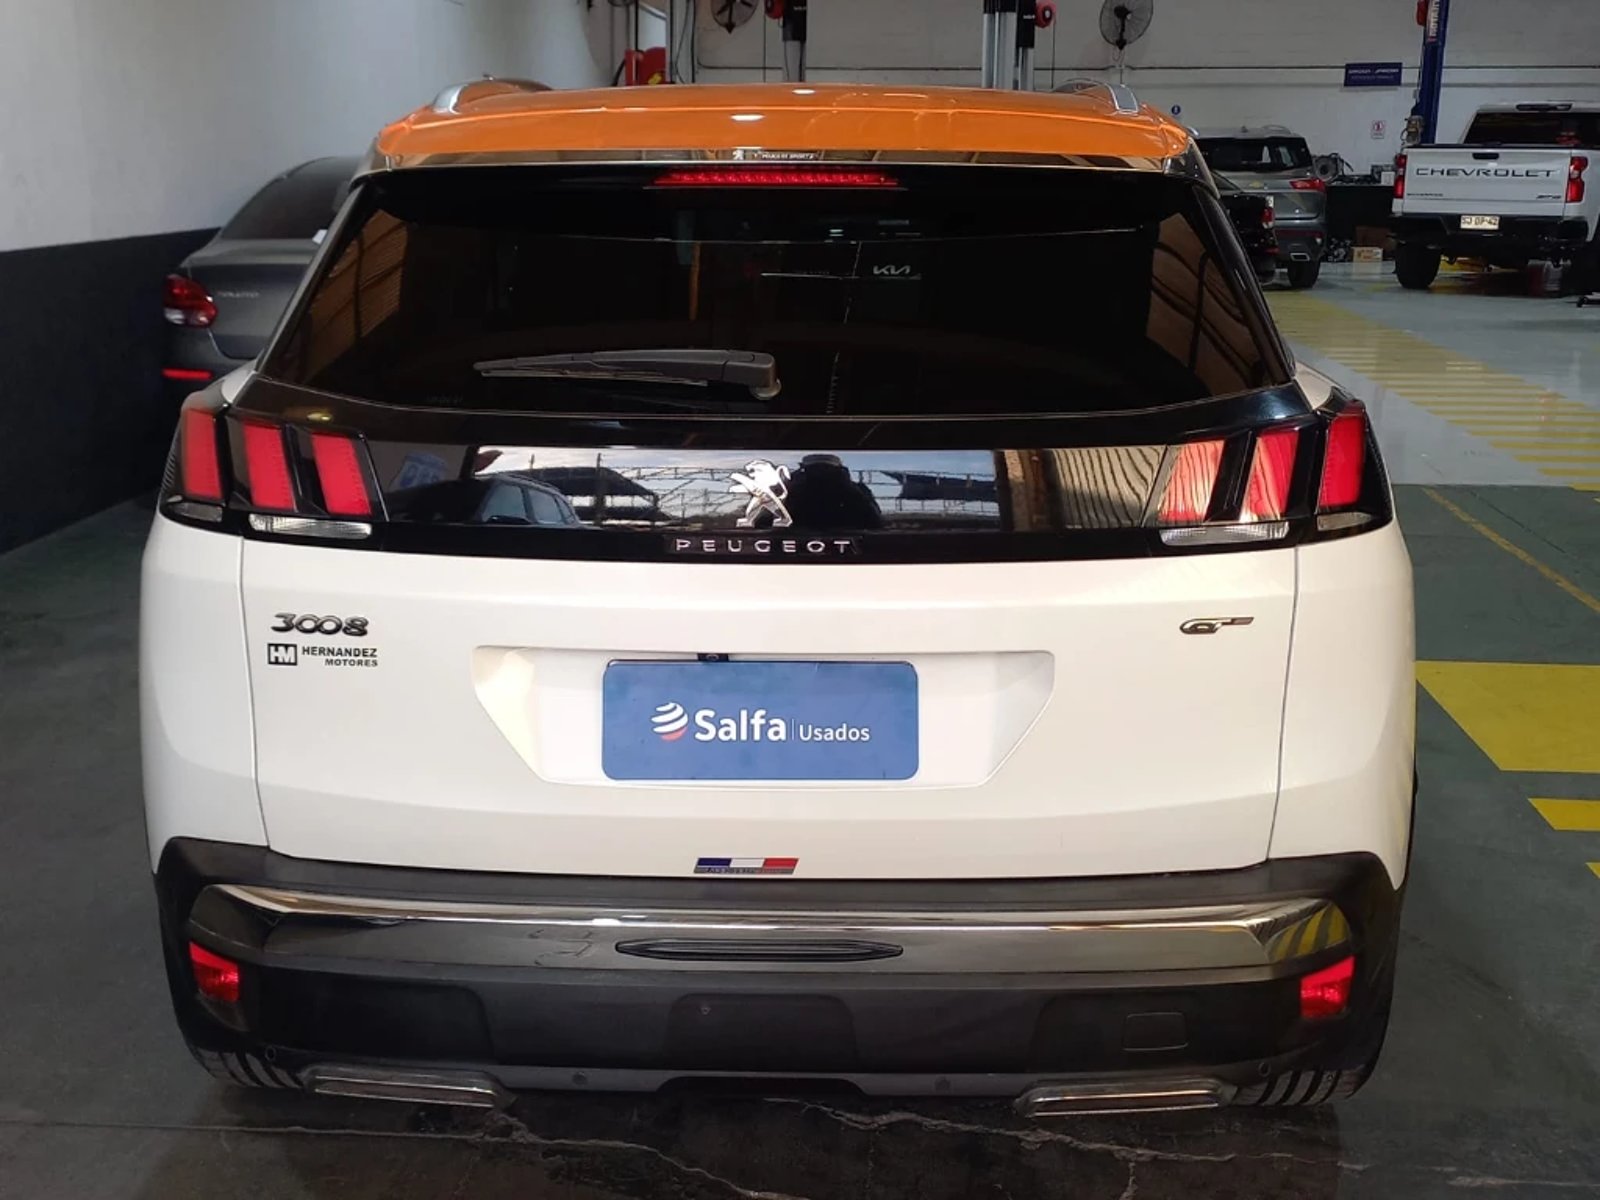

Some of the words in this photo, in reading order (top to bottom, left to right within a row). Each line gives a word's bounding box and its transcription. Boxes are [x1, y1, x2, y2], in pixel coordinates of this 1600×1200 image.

[1416, 168, 1559, 178] CHEVROLET
[676, 538, 851, 553] PEUGEOT
[270, 612, 370, 637] 3008
[267, 643, 298, 666] HM
[301, 646, 378, 658] HERNANDEZ
[324, 658, 378, 667] MOTORES
[694, 709, 787, 742] Salfa
[799, 723, 870, 742] Usados
